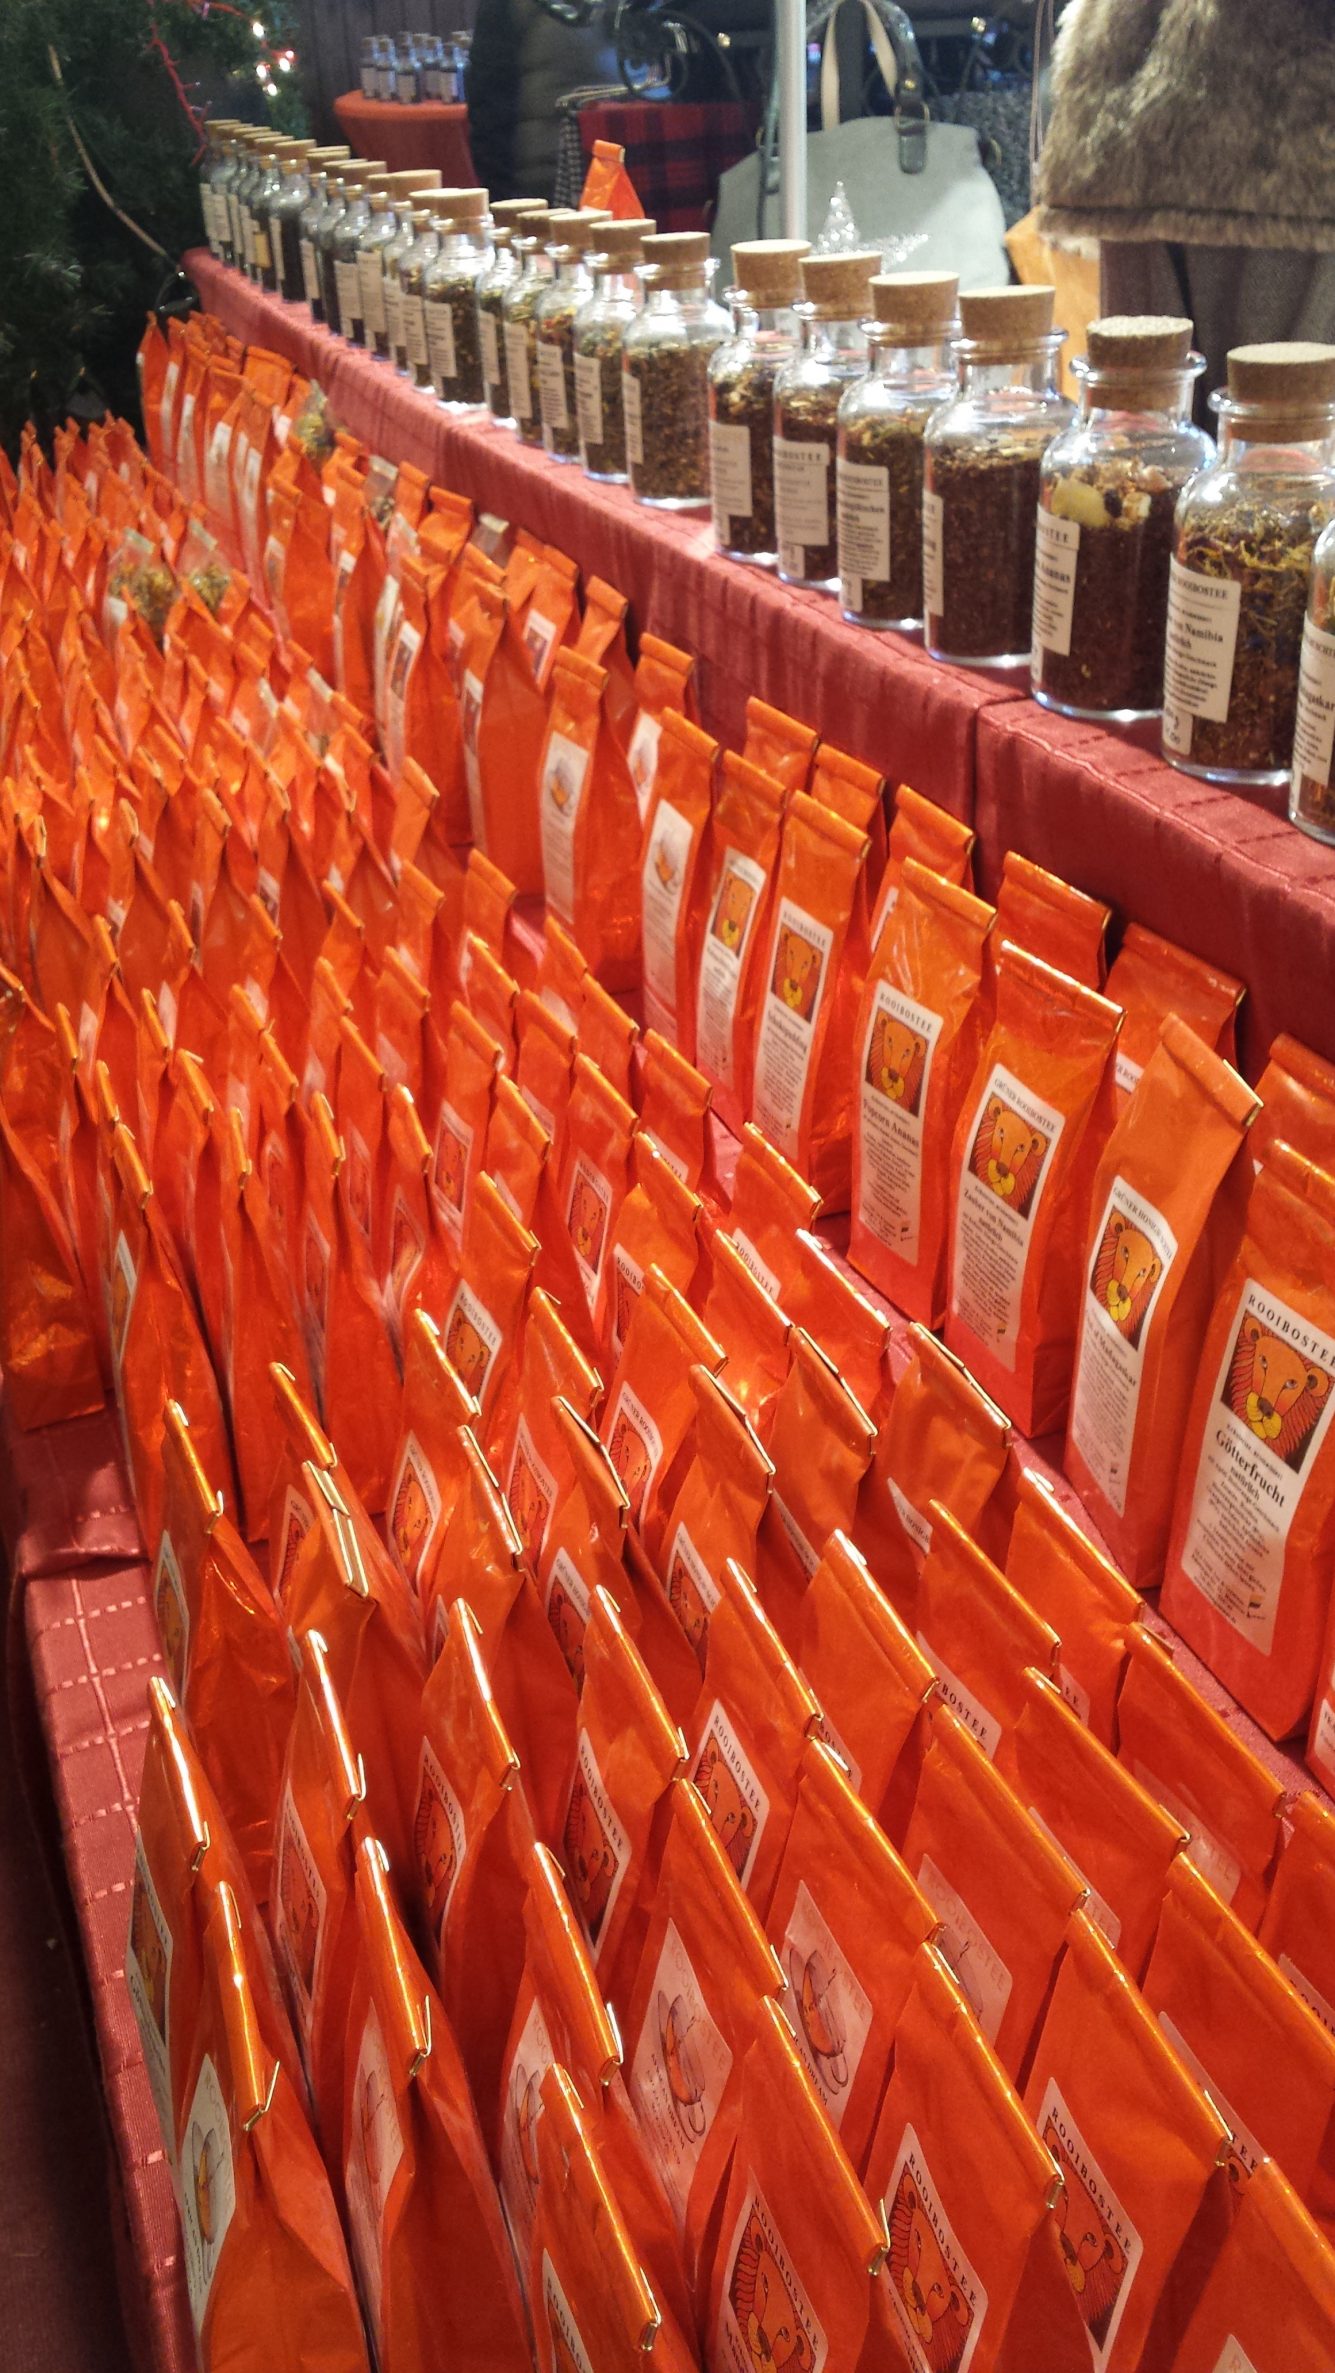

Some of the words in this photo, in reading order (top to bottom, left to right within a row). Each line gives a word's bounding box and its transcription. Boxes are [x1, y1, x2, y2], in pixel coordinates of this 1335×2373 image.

[1185, 623, 1224, 643] Namibia
[891, 1121, 920, 1148] Ananas
[1216, 1429, 1285, 1508] Götterfrucht
[939, 1681, 989, 1742] BOSTEE
[580, 1744, 625, 1853] ROOIBOSTEE
[715, 1714, 761, 1812] ROOIBOSTEE
[1051, 2106, 1133, 2253] ROOIBOSTEE
[754, 2196, 819, 2352] ROOIBOSTEE
[909, 2153, 977, 2307] ROOIBOSTEE
